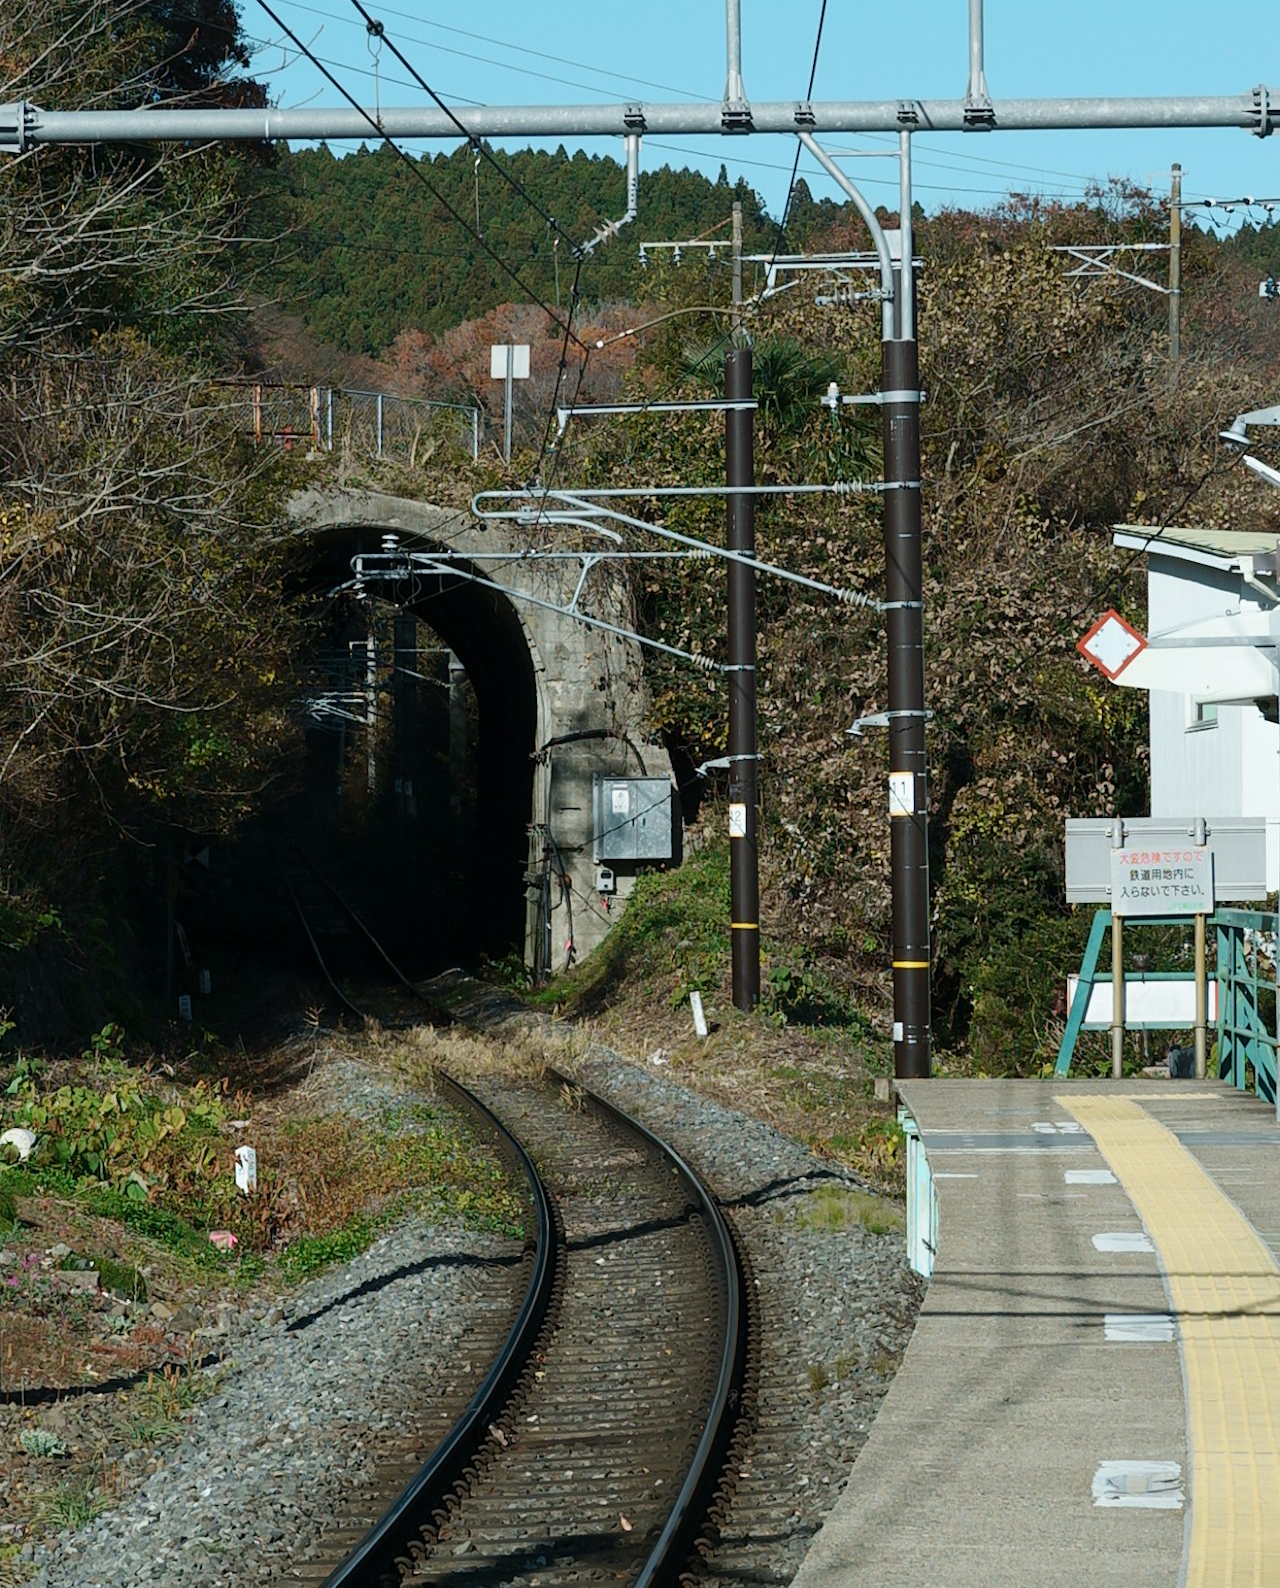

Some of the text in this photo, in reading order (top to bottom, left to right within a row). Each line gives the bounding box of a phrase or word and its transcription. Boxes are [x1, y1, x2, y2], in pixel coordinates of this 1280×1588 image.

[892, 781, 906, 795] 11
[1120, 850, 1203, 864] 大変危険ですので
[1129, 867, 1194, 881] 鉄道用地内に
[1120, 884, 1205, 899] 入らないで下さい。
